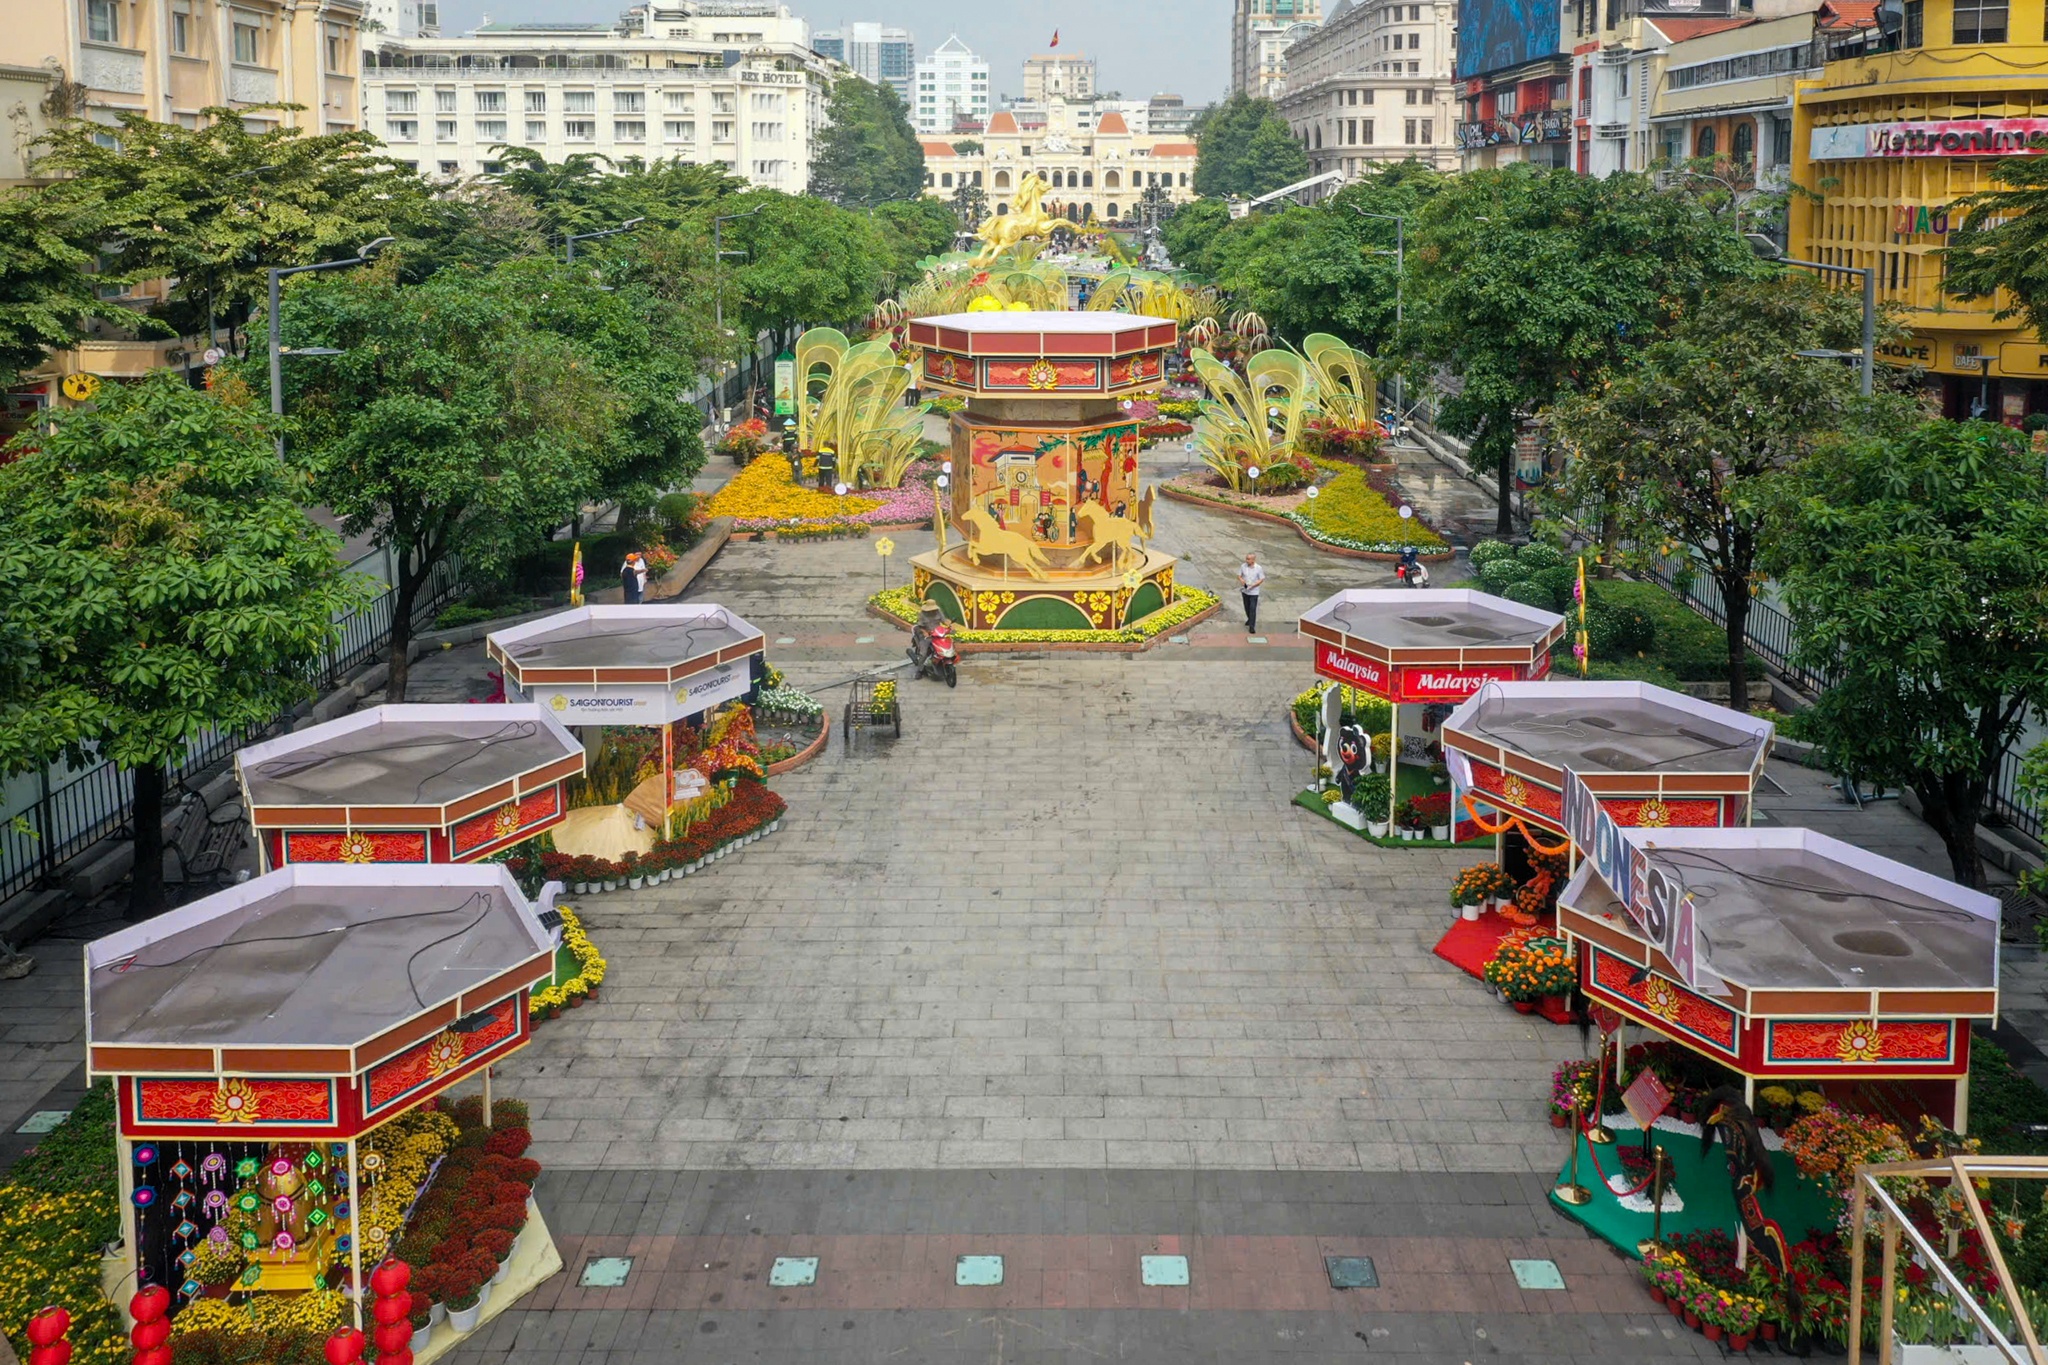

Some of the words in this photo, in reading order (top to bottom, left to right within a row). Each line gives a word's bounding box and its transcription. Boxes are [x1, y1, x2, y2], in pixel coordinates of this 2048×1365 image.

[741, 71, 759, 82] REX
[763, 72, 801, 84] HOTEL
[1893, 205, 1948, 234] CIAO
[1891, 345, 1929, 360] CAFÉ
[1326, 651, 1380, 682] Malaysia
[689, 674, 731, 696] SAIGONTOURIST
[570, 698, 633, 708] SAIGONTOURIST
[1562, 763, 1695, 990] INDONESIA
